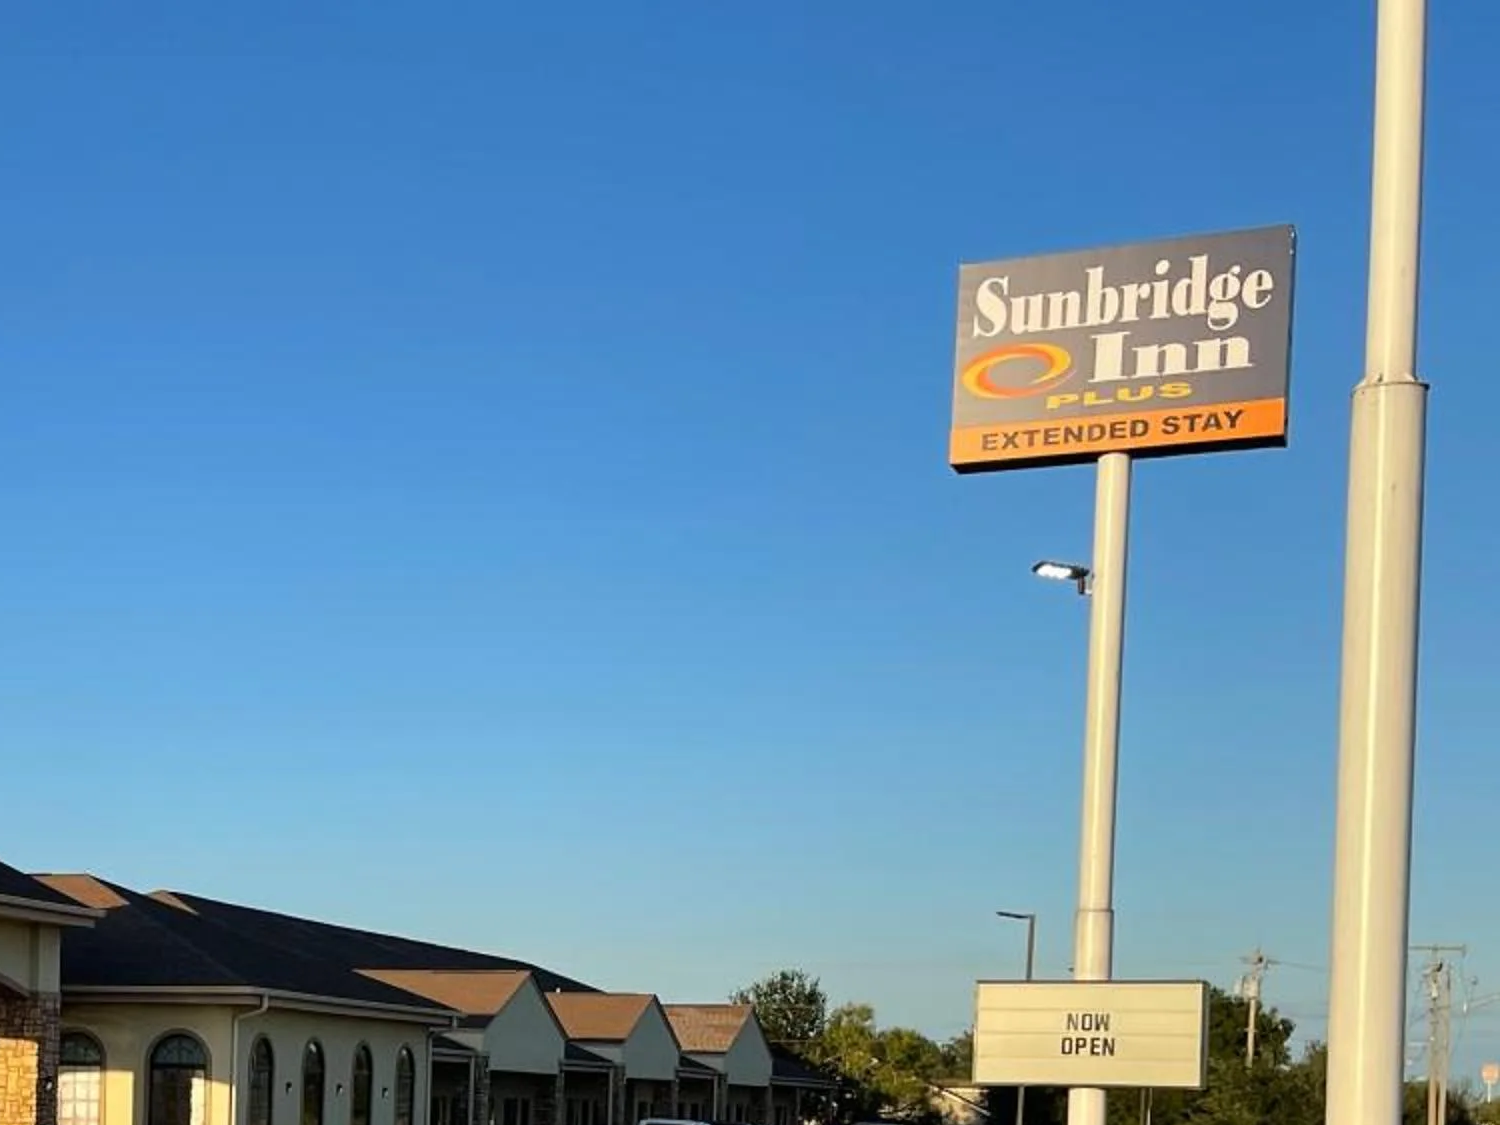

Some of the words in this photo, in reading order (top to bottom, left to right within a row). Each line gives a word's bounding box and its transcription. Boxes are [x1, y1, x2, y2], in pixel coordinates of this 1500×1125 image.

[973, 254, 1273, 337] Sunbridge
[1088, 331, 1253, 383] Inn
[1046, 382, 1192, 409] PLUS
[981, 420, 1150, 451] EXTENDED
[1161, 409, 1244, 435] STAY
[1067, 1013, 1110, 1031] NOW
[1061, 1037, 1115, 1056] OPEN
